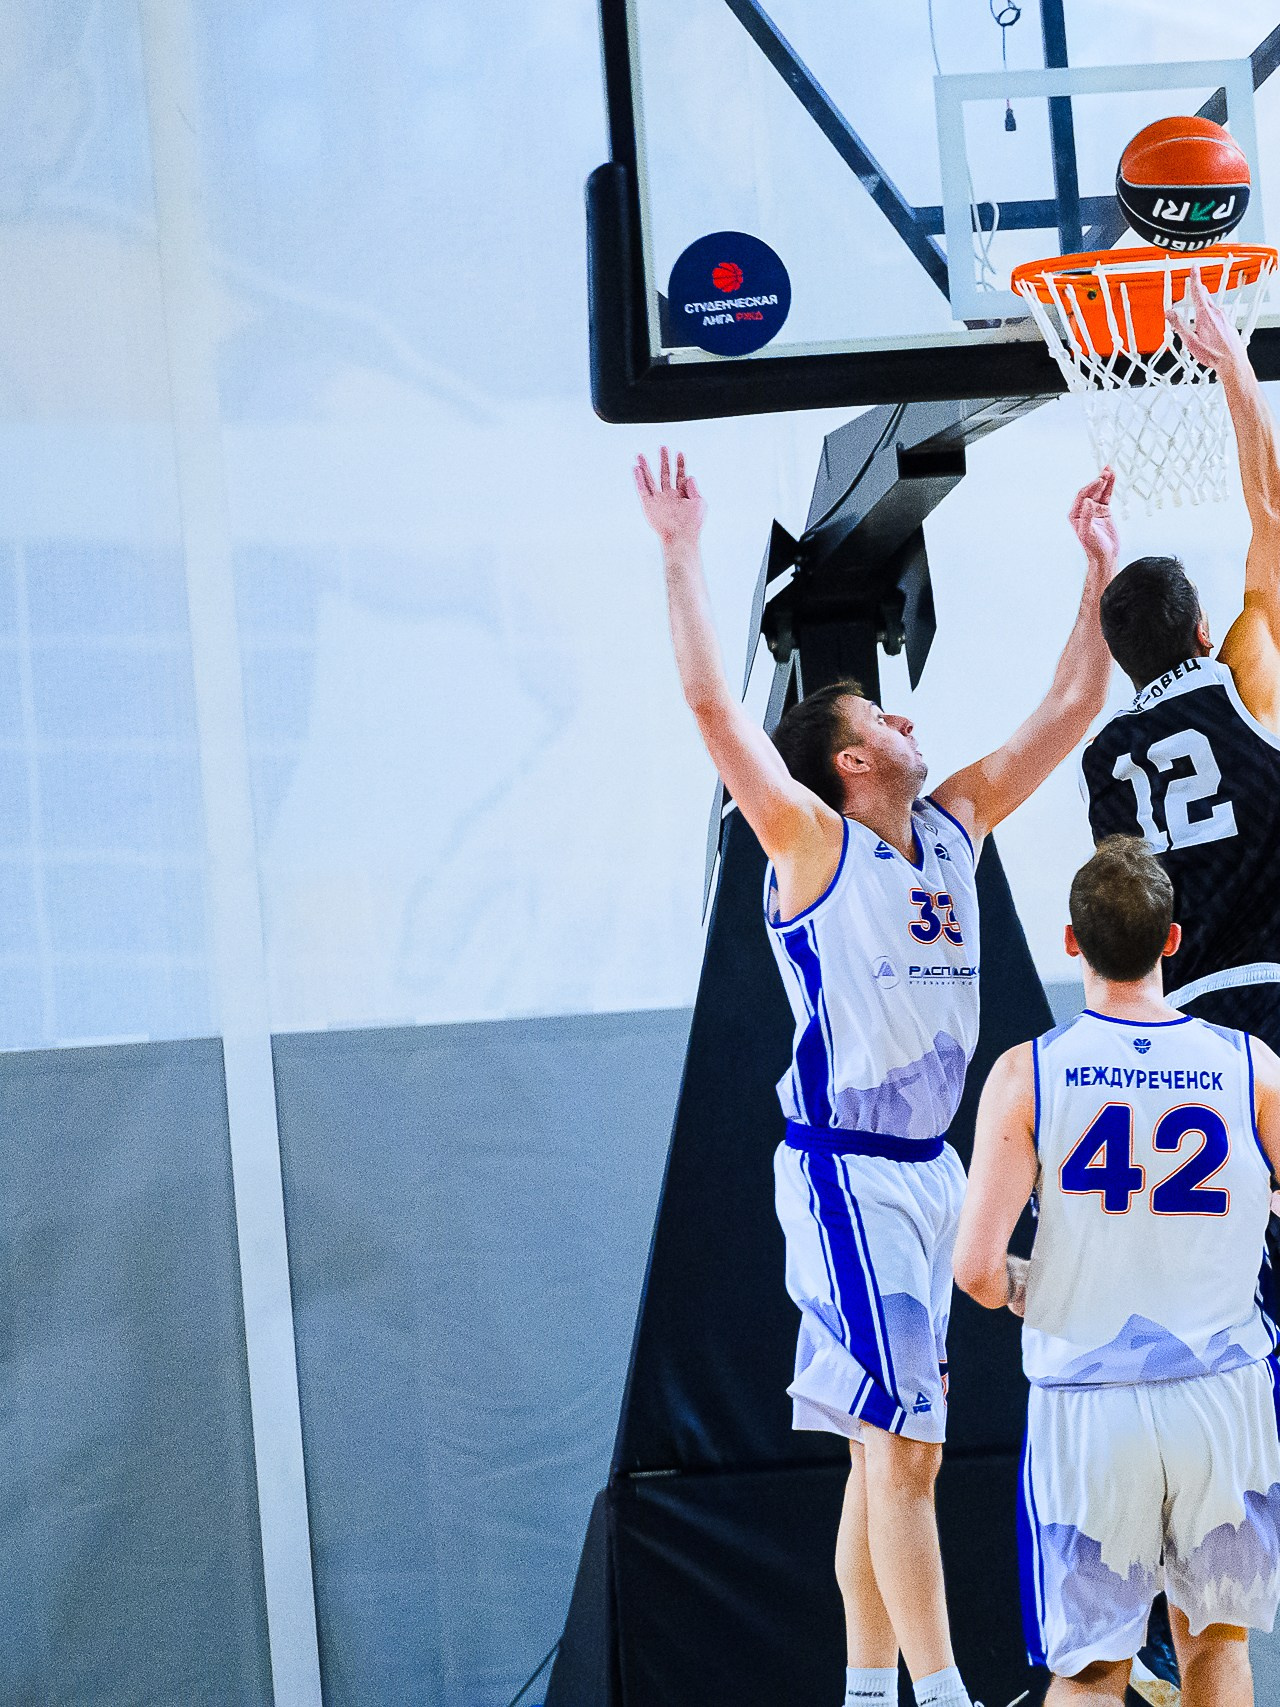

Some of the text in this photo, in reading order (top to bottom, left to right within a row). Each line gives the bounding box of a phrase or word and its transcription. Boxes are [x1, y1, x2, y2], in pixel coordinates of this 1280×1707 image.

[1152, 195, 1236, 221] PARI
[684, 294, 778, 313] СТУДЕНЧЕСКАЯ
[702, 313, 735, 326] ЛИГА
[1112, 729, 1239, 855] 12
[908, 887, 964, 946] 33
[1065, 1066, 1223, 1090] МЕЖДУРЕЧЕНСК
[1058, 1101, 1232, 1217] 42
